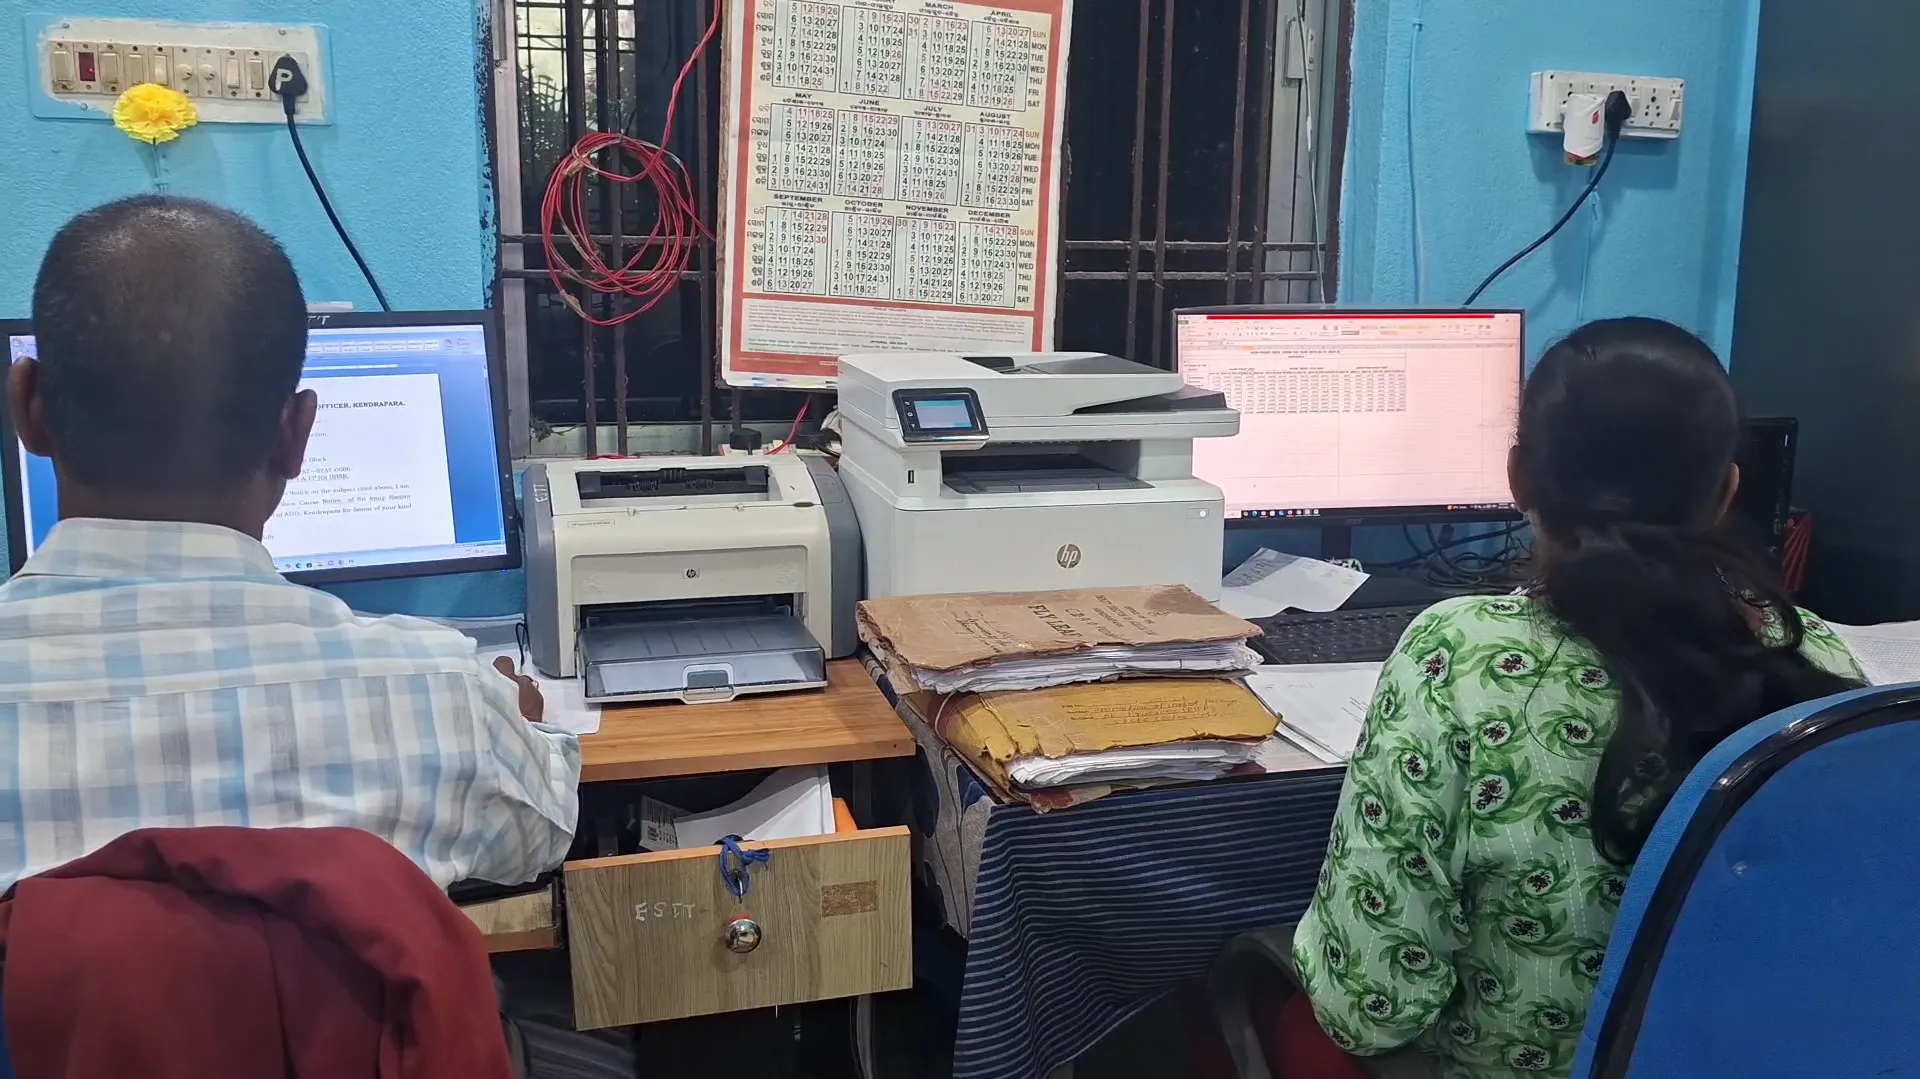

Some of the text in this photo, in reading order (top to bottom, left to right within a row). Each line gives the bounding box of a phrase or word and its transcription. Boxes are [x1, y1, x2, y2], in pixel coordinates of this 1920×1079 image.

[925, 2, 954, 10] MARCH
[991, 10, 1013, 18] APRIL
[869, 24, 879, 32] 10
[893, 27, 903, 35] 24
[909, 28, 917, 36] 31
[933, 31, 942, 39] 10
[801, 41, 811, 49] 15
[813, 42, 823, 50] 22
[826, 43, 836, 51] 29
[1031, 42, 1047, 50] MON
[1031, 54, 1044, 62] TUE
[995, 62, 1004, 70] 16
[1006, 62, 1016, 71] 23
[1017, 64, 1027, 72] 30
[275, 68, 294, 91] P
[1029, 77, 1042, 85] THU
[864, 127, 873, 135] 16
[876, 128, 885, 136] 23
[1024, 153, 1037, 161] TUE
[795, 168, 805, 176] 16
[819, 170, 830, 178] 30
[913, 167, 922, 175] 10
[773, 194, 823, 203] SEPTEMBER
[986, 196, 995, 204] 16
[997, 197, 1007, 205] 23
[1009, 198, 1019, 206] 30
[845, 200, 883, 208] OCTOBER
[906, 204, 949, 213] NOVEMBER
[968, 210, 1011, 218] DECEMBER
[793, 222, 802, 231] 15
[805, 223, 815, 232] 22
[816, 224, 826, 232] 29
[984, 237, 993, 245] 15
[1007, 238, 1017, 246] 29
[844, 273, 854, 281] 10
[868, 274, 877, 282] 24
[880, 275, 889, 283] 31
[1018, 273, 1031, 281] THU
[919, 289, 928, 297] 15
[930, 289, 940, 298] 22
[942, 290, 952, 298] 29
[1057, 544, 1081, 568] hp
[1027, 604, 1058, 619] FLY
